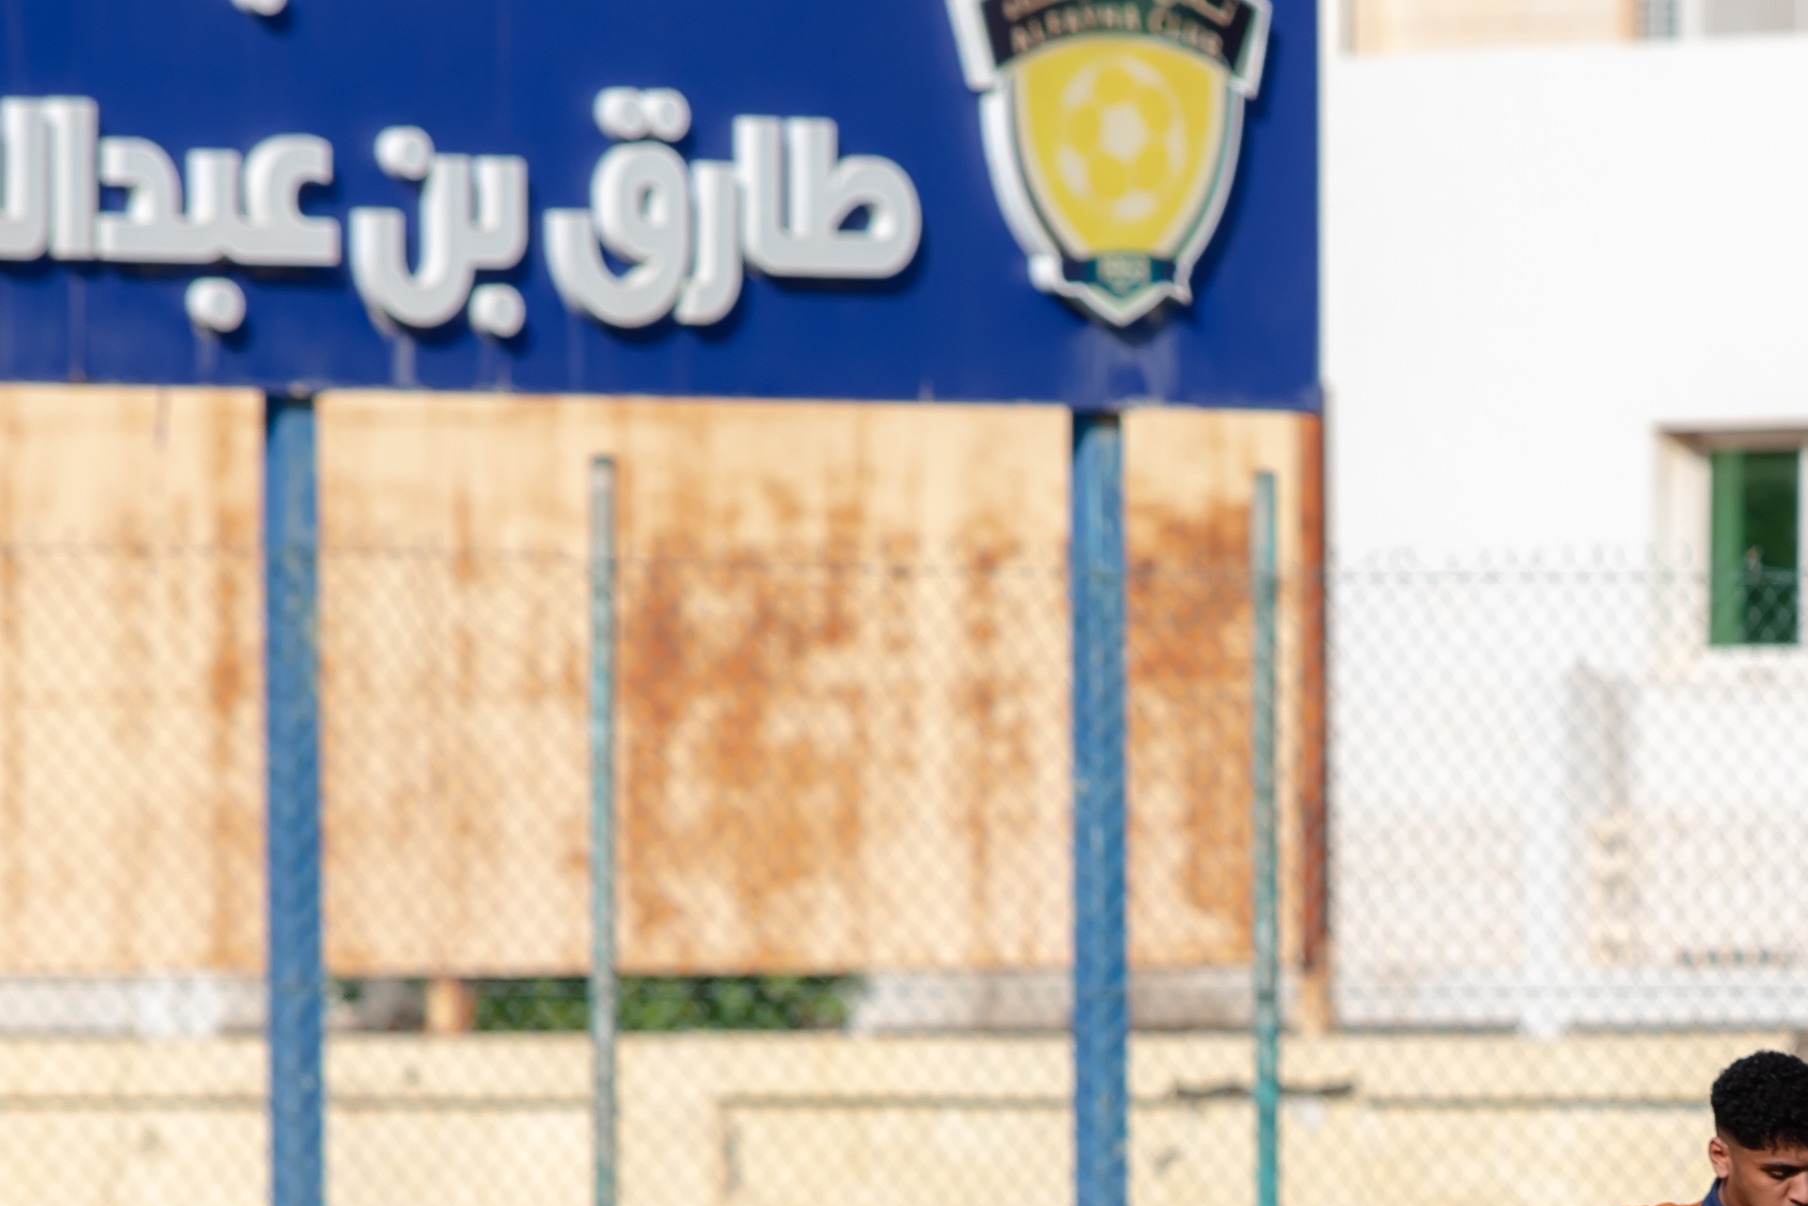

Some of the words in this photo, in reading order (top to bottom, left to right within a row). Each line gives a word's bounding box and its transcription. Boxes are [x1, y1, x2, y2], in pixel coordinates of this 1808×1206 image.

[0, 96, 341, 333] عبدال
[349, 125, 529, 337] بن
[543, 86, 922, 328] طارق
